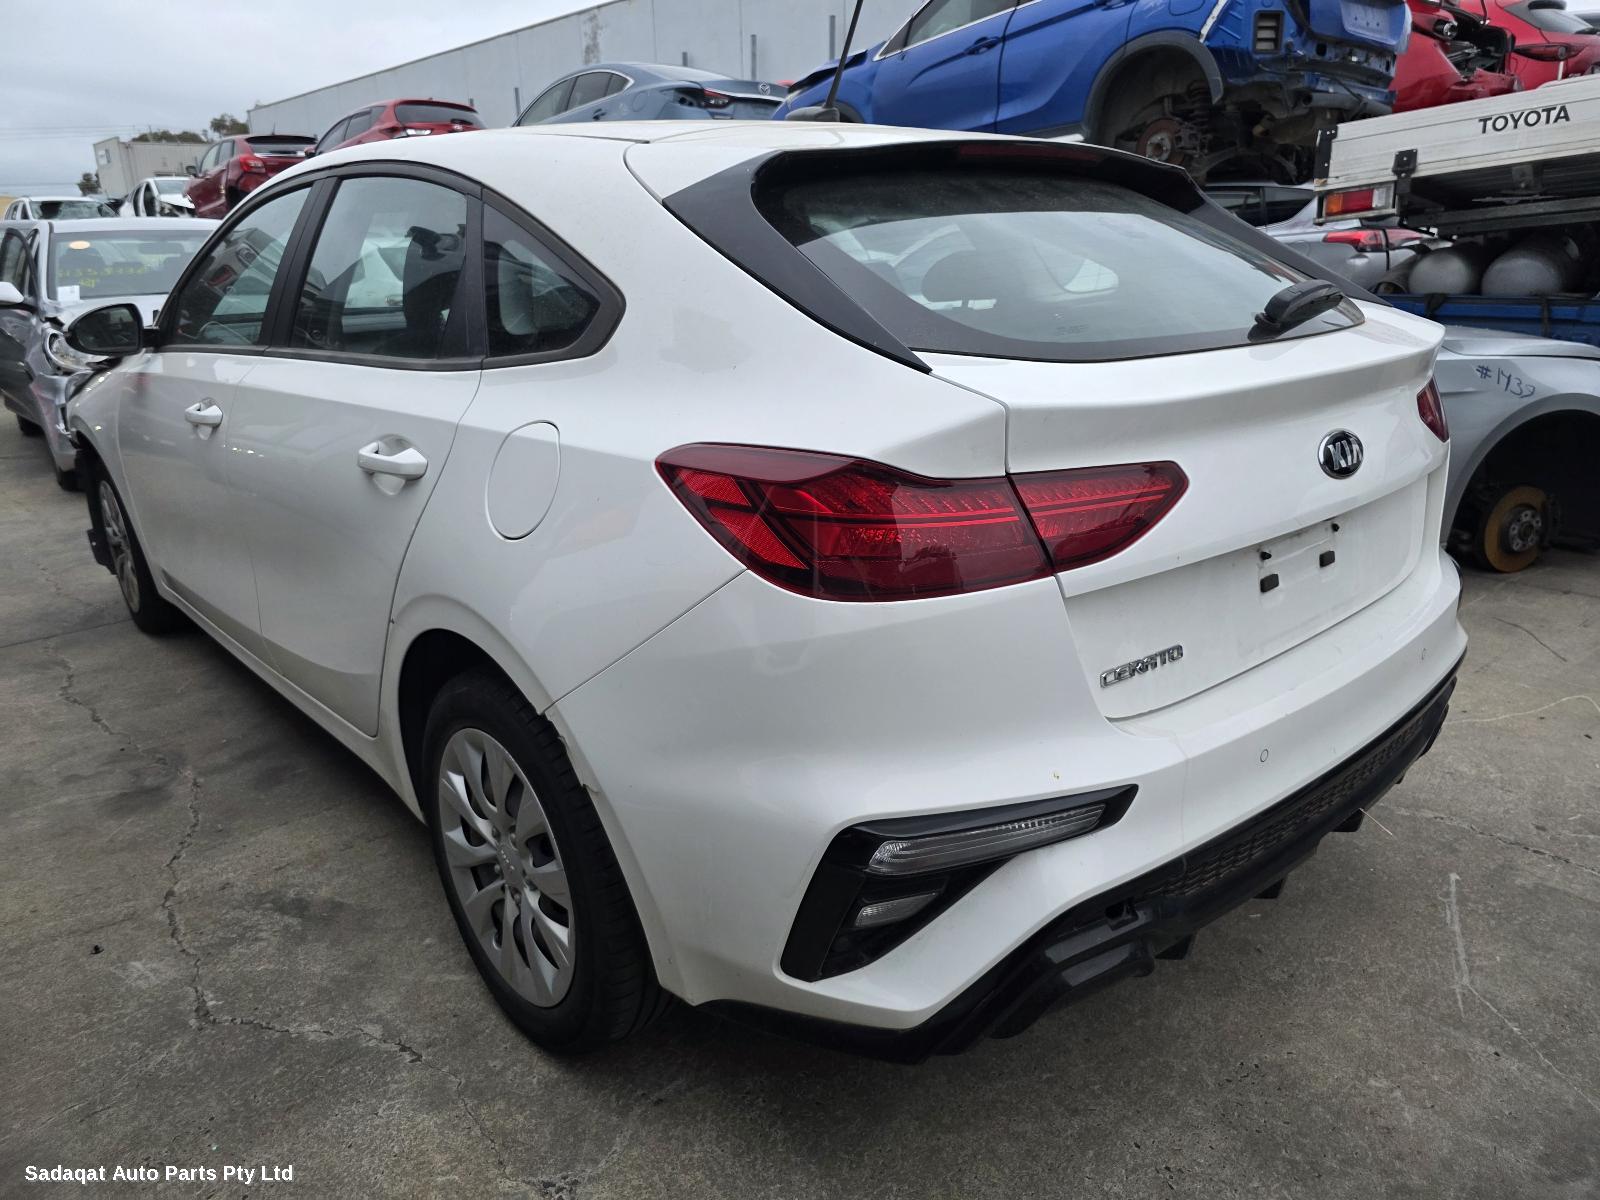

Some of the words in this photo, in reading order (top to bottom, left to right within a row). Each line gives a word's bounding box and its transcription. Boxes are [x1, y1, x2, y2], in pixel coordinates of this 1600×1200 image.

[1478, 105, 1570, 134] TOYOTA
[1327, 438, 1362, 470] KIA
[1100, 644, 1184, 688] CERATO
